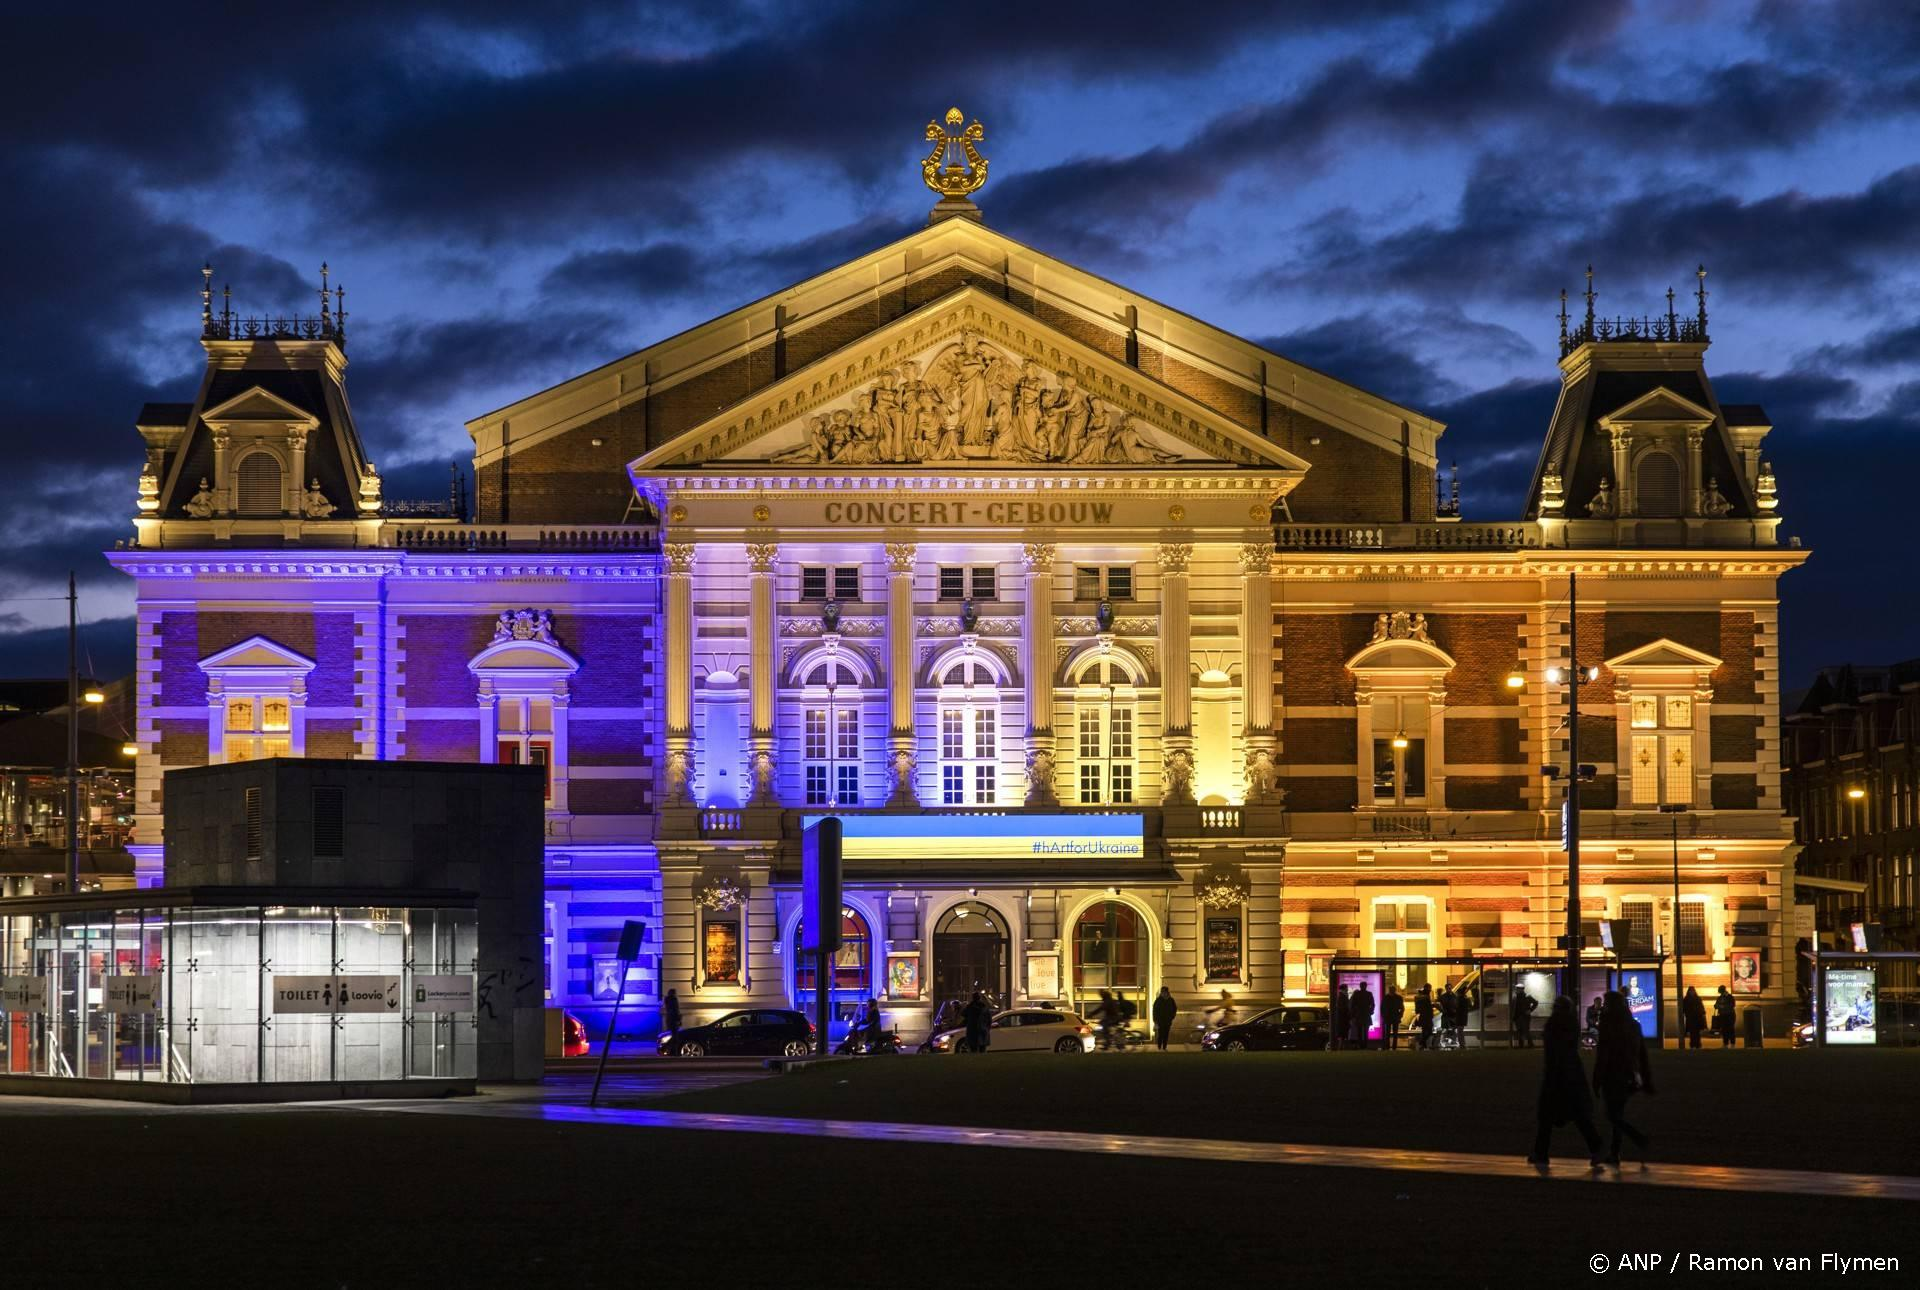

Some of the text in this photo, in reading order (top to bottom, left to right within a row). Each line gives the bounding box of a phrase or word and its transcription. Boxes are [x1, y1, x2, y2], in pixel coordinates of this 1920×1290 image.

[825, 502, 1114, 524] CONCERT-GEBOUW
[1032, 840, 1140, 854] #hArtforUkraine
[280, 990, 383, 1001] TOILET loovio
